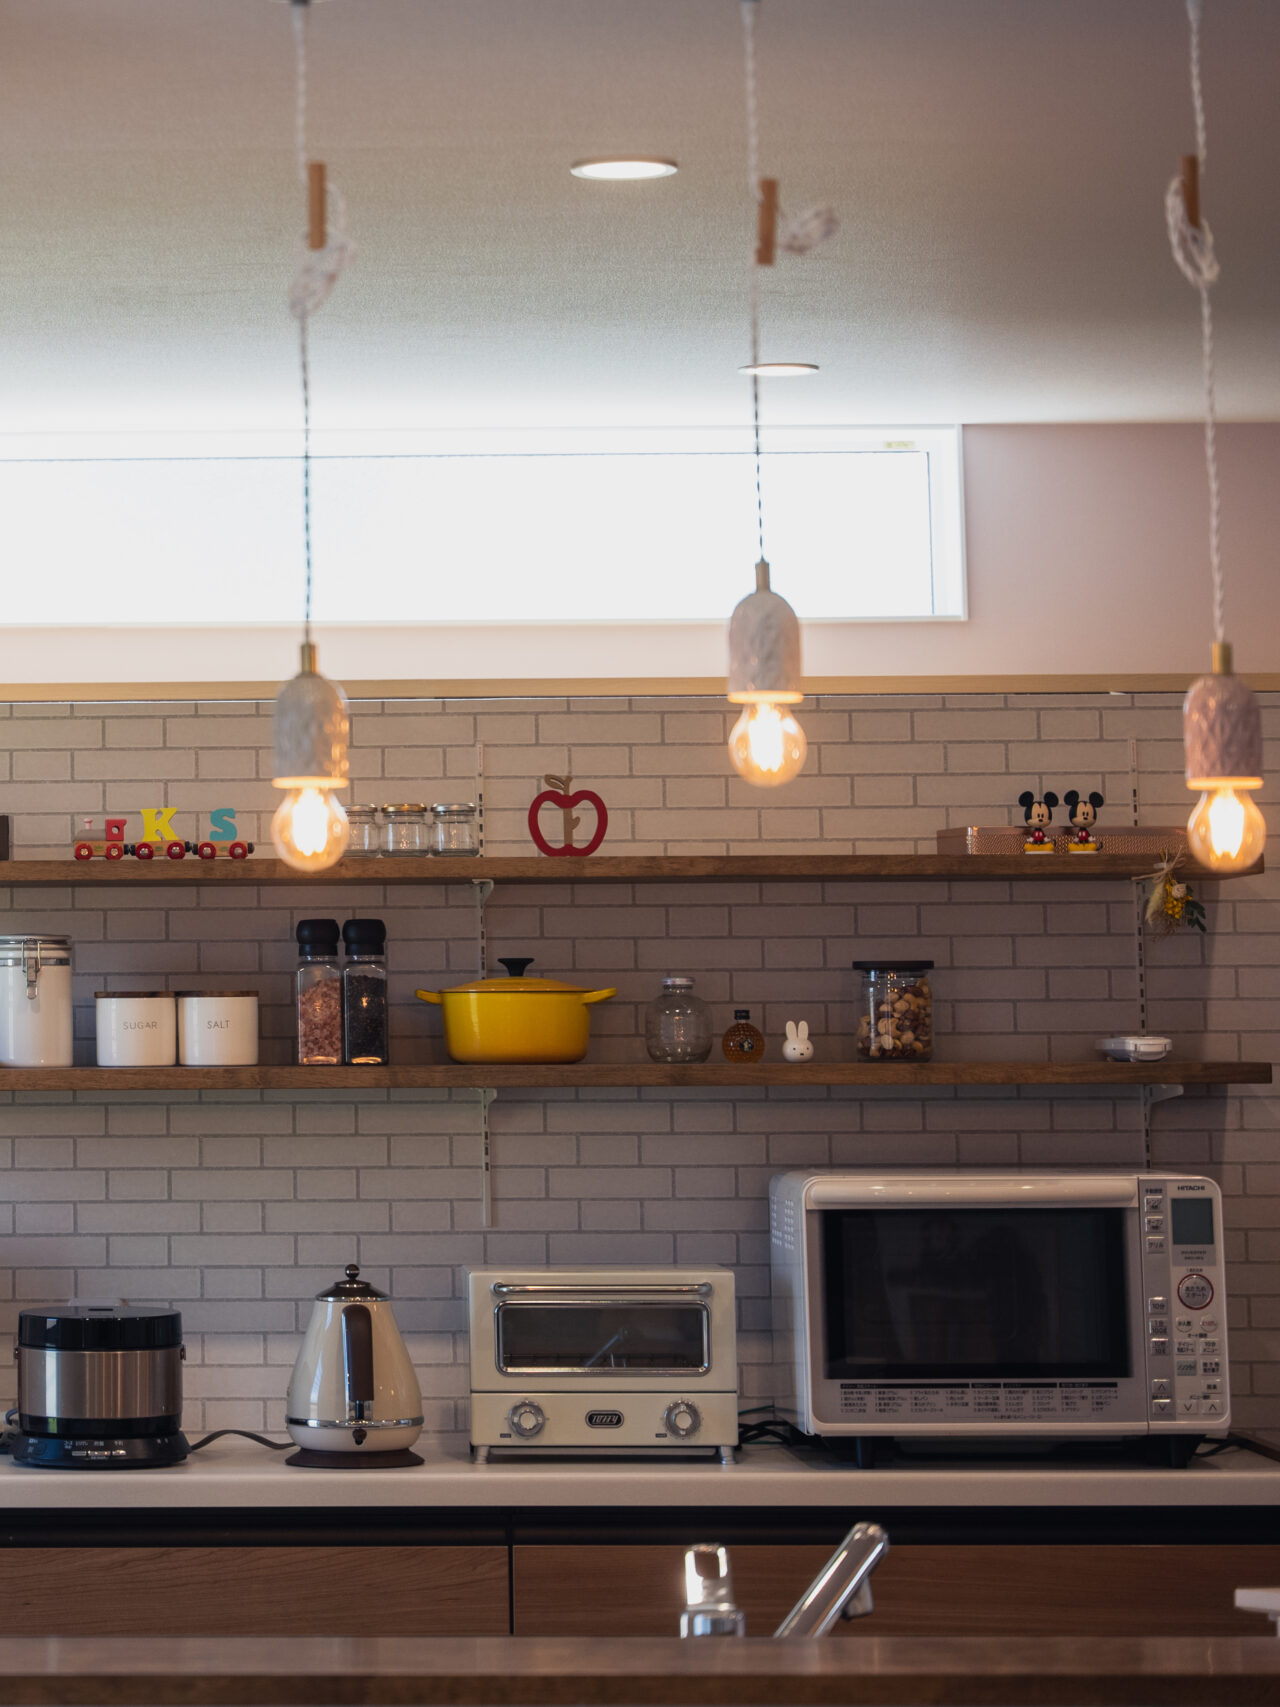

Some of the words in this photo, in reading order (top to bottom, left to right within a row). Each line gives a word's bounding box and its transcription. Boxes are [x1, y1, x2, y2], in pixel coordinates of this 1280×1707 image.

[140, 807, 178, 841] K
[209, 807, 237, 841] S
[123, 1021, 158, 1030] SUGAR
[207, 1019, 231, 1029] SALT
[1152, 1302, 1165, 1310] 10分
